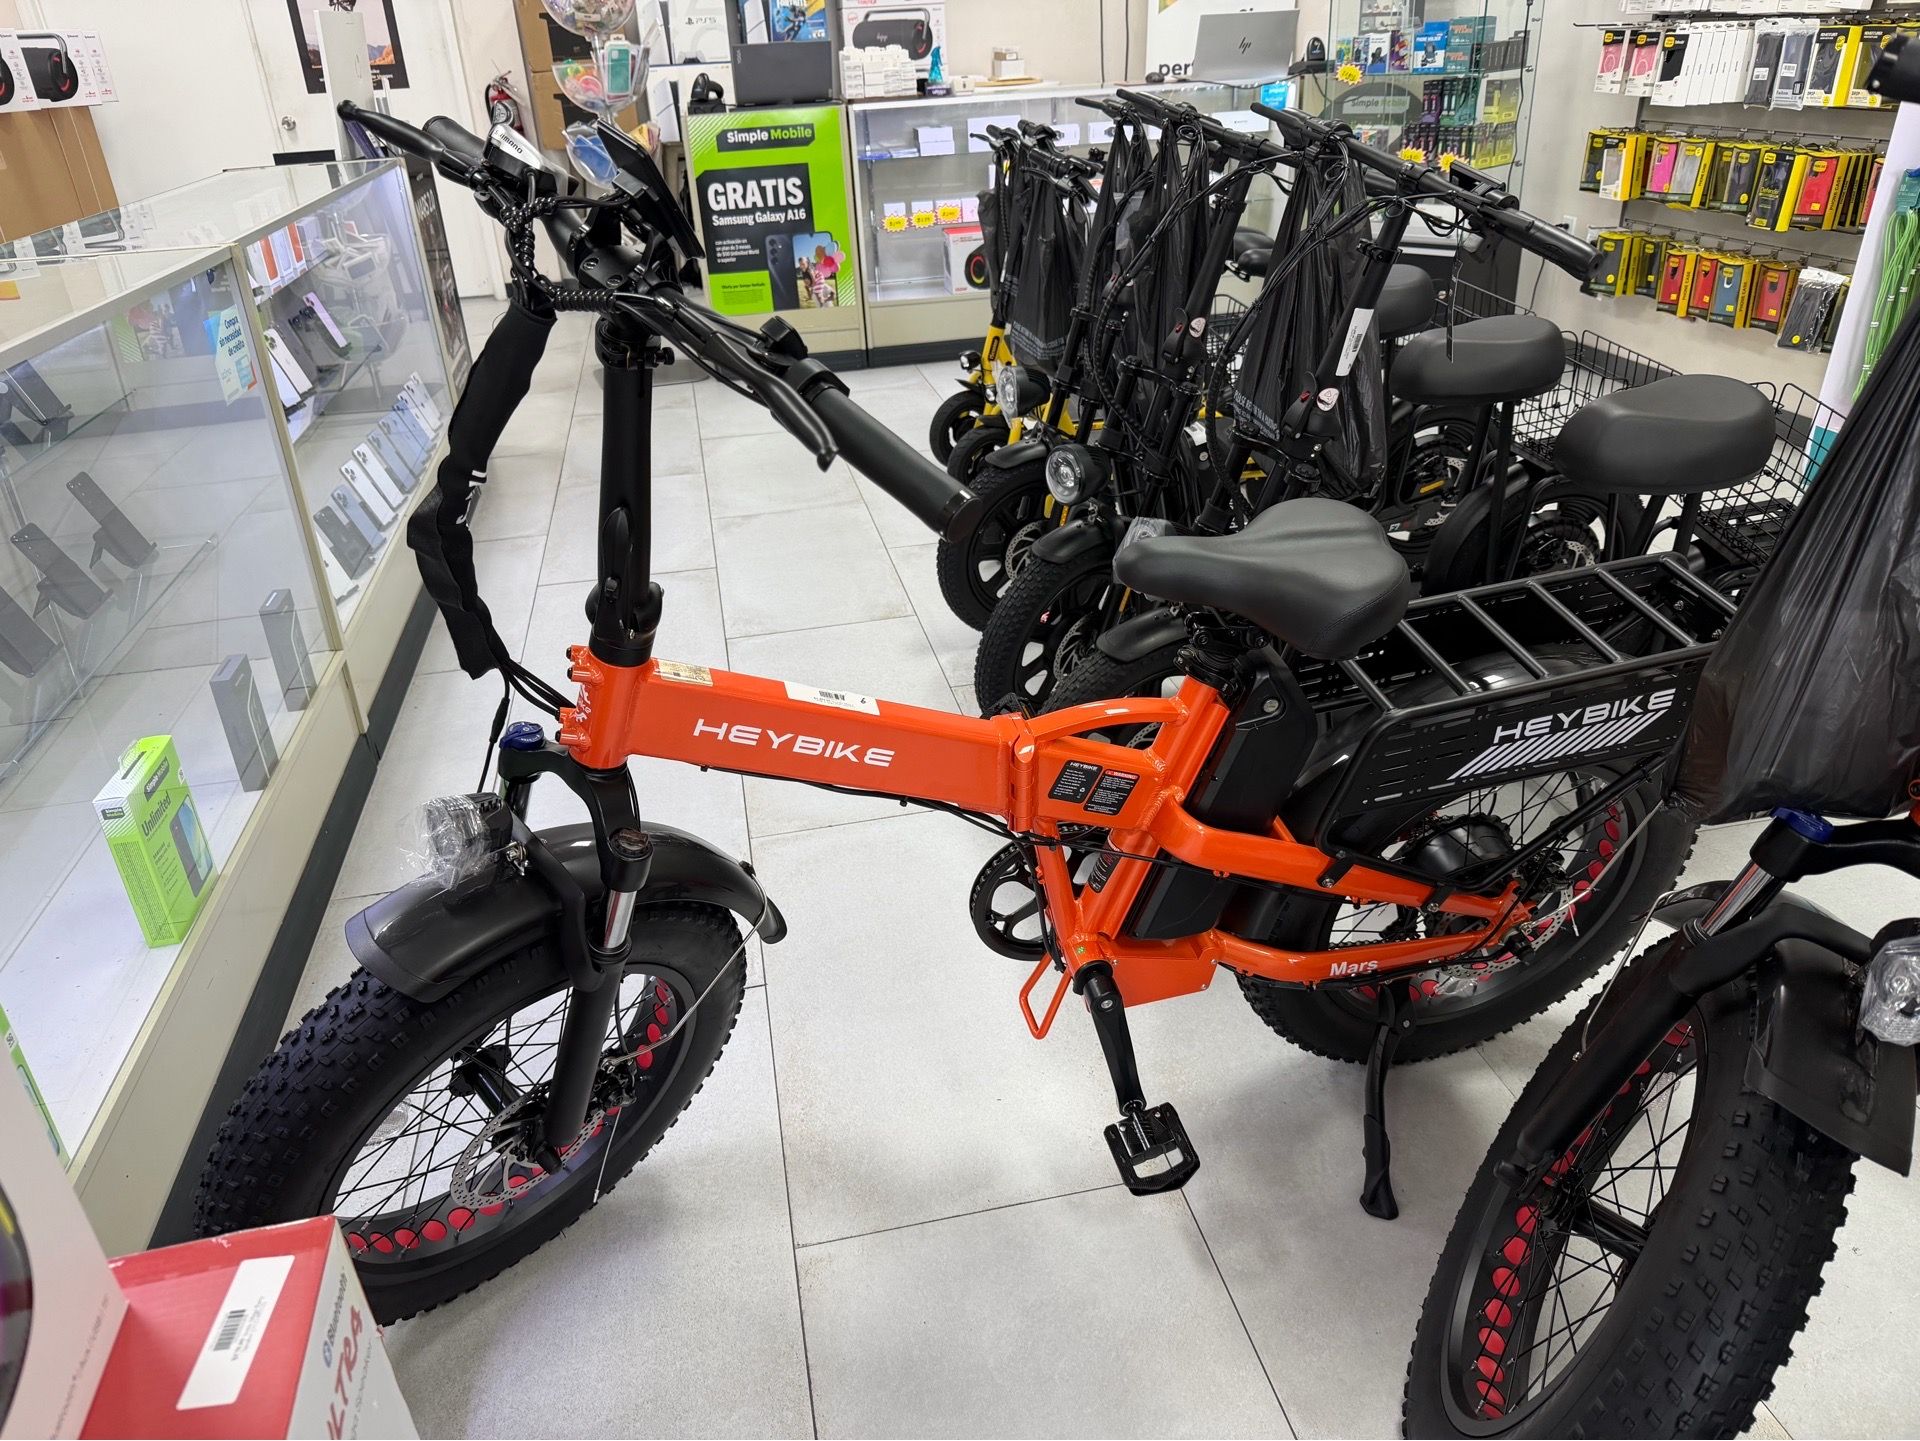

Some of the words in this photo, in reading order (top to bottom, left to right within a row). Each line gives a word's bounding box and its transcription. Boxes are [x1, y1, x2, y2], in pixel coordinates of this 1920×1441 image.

[1351, 98, 1380, 110] Simple
[727, 129, 769, 145] Simple
[770, 126, 813, 140] Mobile
[707, 176, 805, 212] GRATIS
[1759, 186, 1779, 195] Defender
[1829, 191, 1838, 211] PHONE
[712, 213, 754, 227] Samsung
[755, 211, 786, 225] Galaxy
[787, 209, 806, 221] A16
[224, 316, 239, 330] Compra
[224, 328, 242, 343] necesidad
[233, 340, 245, 354] crédito
[1389, 522, 1401, 532] F7
[1493, 688, 1676, 744] HEYBIKE
[693, 718, 895, 767] HEYBIKE
[1070, 762, 1098, 771] HEYBIKE
[142, 789, 171, 837] Unlimited
[1329, 959, 1378, 977] Mars
[327, 1272, 348, 1346] Bluetooth
[327, 1304, 363, 1441] LTRA
